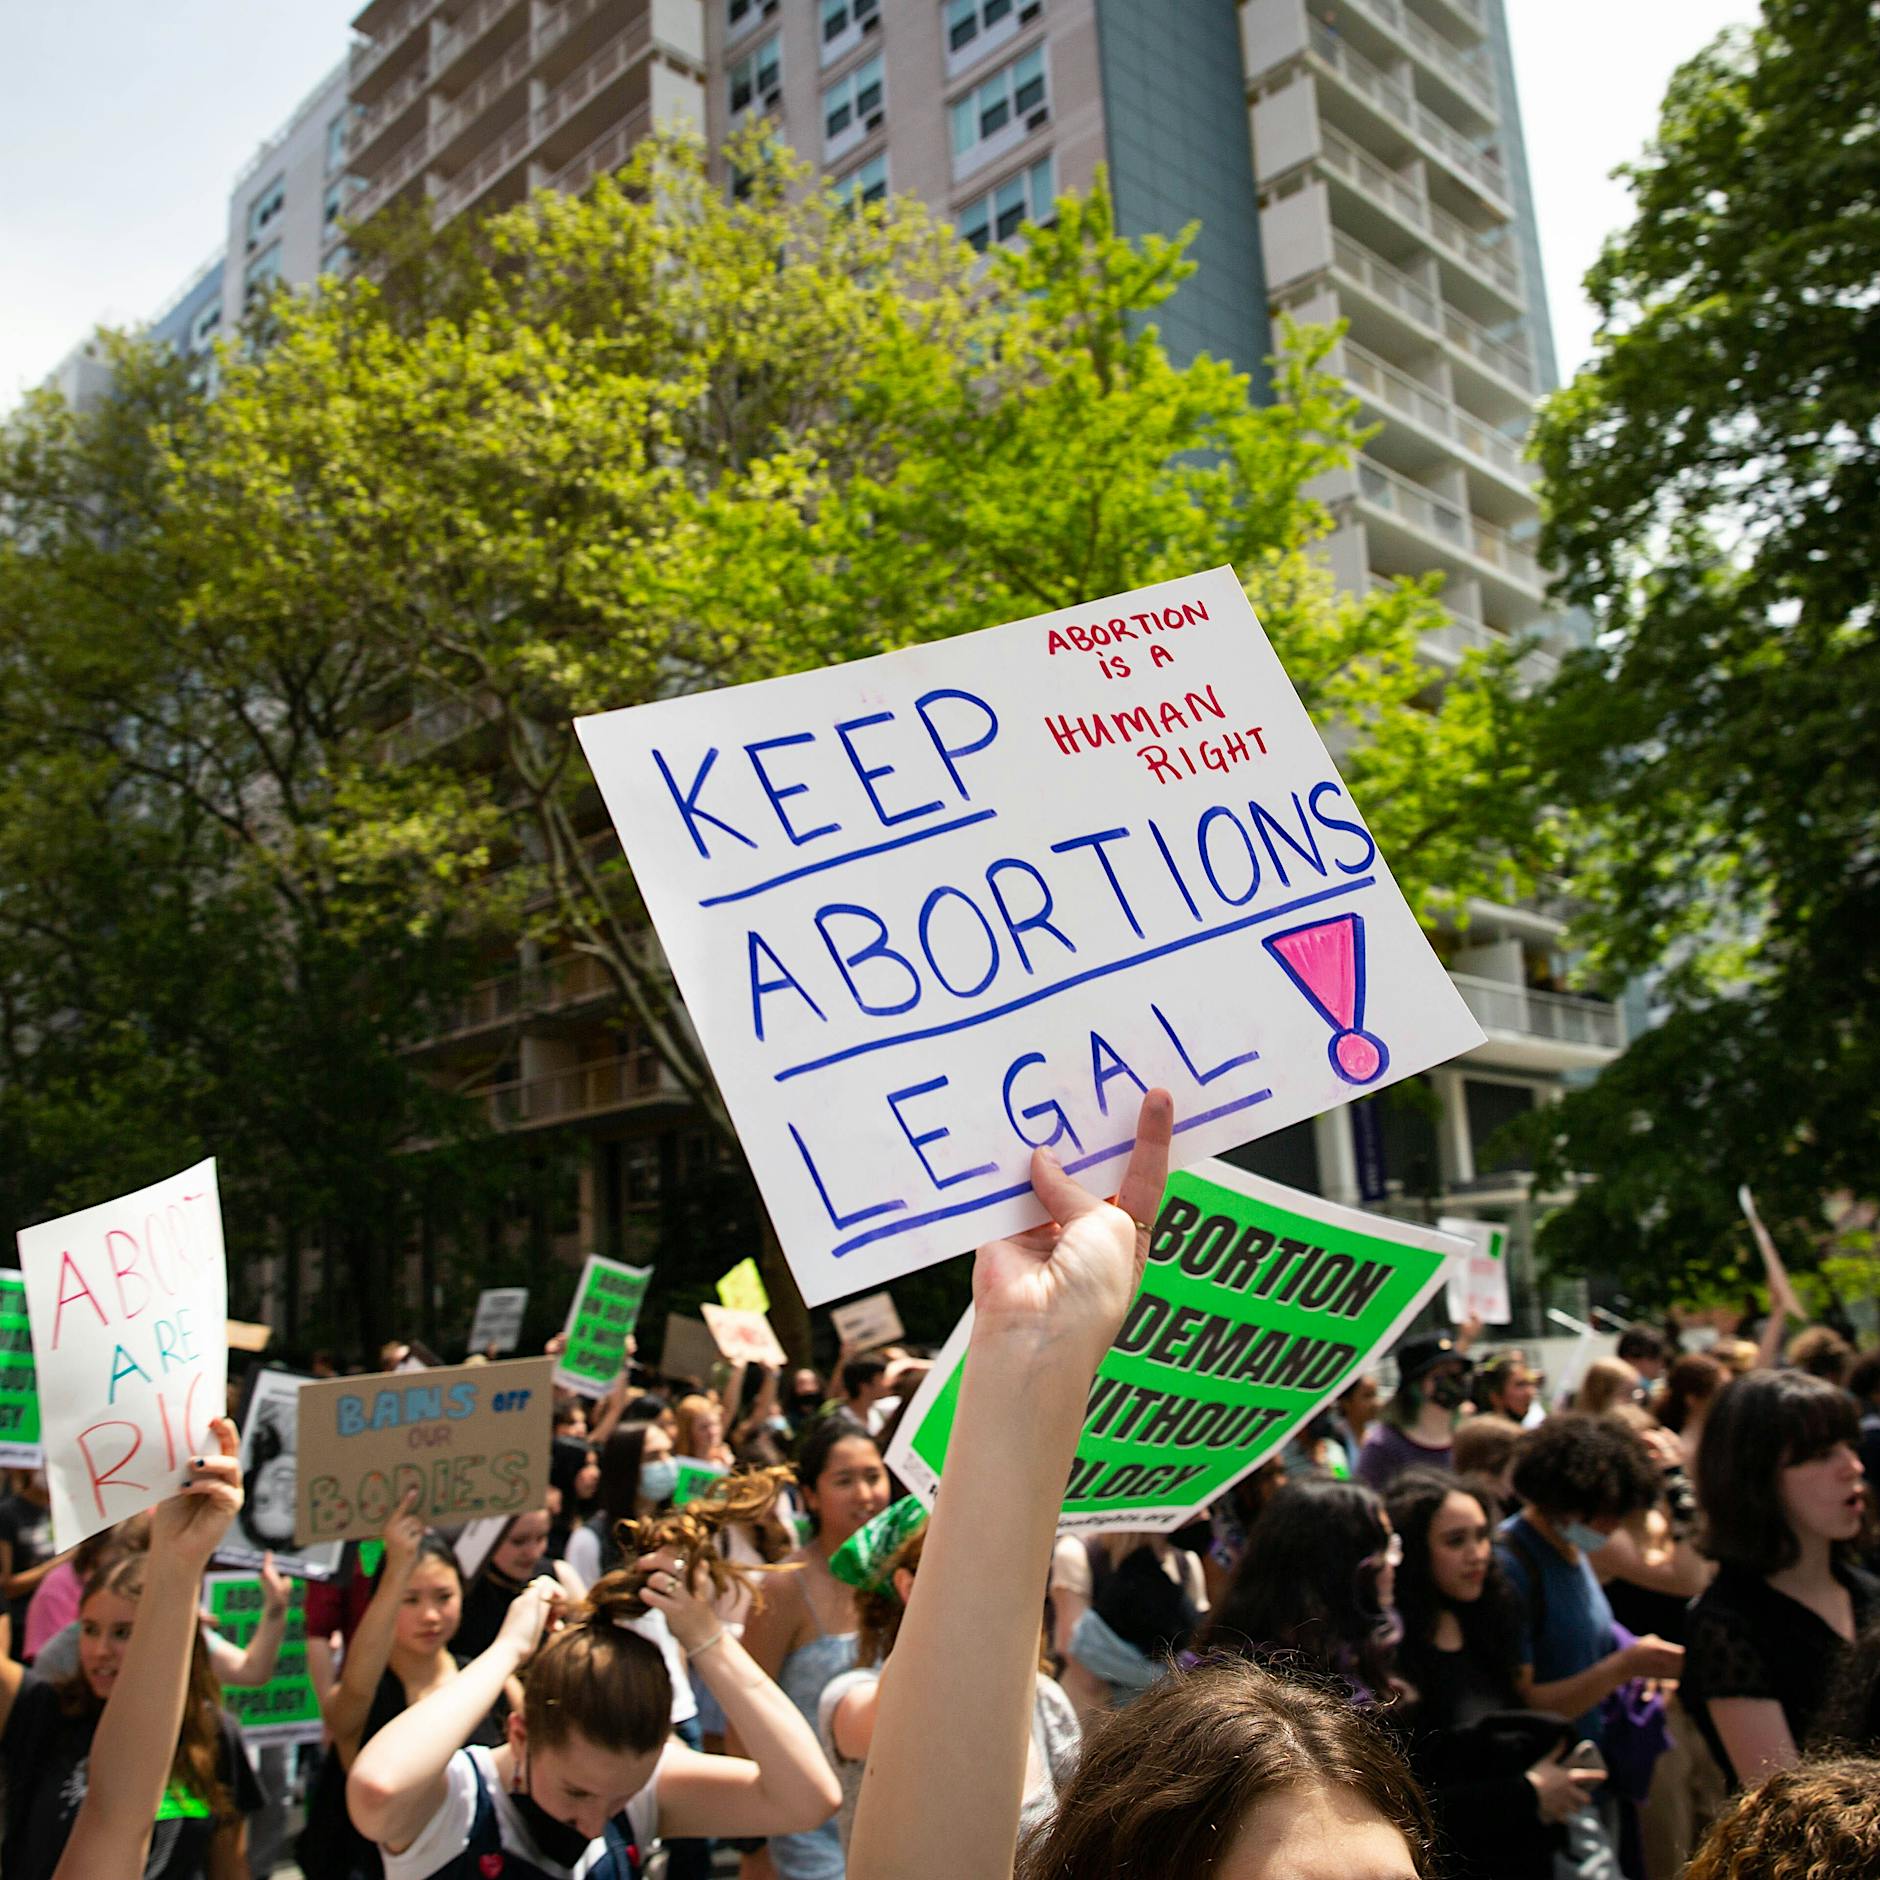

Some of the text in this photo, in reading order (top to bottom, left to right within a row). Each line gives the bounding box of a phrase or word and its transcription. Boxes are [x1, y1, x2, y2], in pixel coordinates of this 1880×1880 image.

[1047, 600, 1210, 655] ABORTION
[1150, 643, 1174, 669] A
[1044, 684, 1226, 756] HUMAN
[1136, 726, 1269, 785] RIGHT
[652, 688, 998, 859] KEEP
[748, 781, 1375, 1042] ABORTIONS
[1147, 1196, 1396, 1320] BORTION
[108, 1308, 200, 1405] ARE
[1113, 1293, 1358, 1392] DEMAND
[336, 1381, 478, 1437] BANS
[407, 1424, 452, 1449] OUR
[308, 1450, 530, 1535] BODIES
